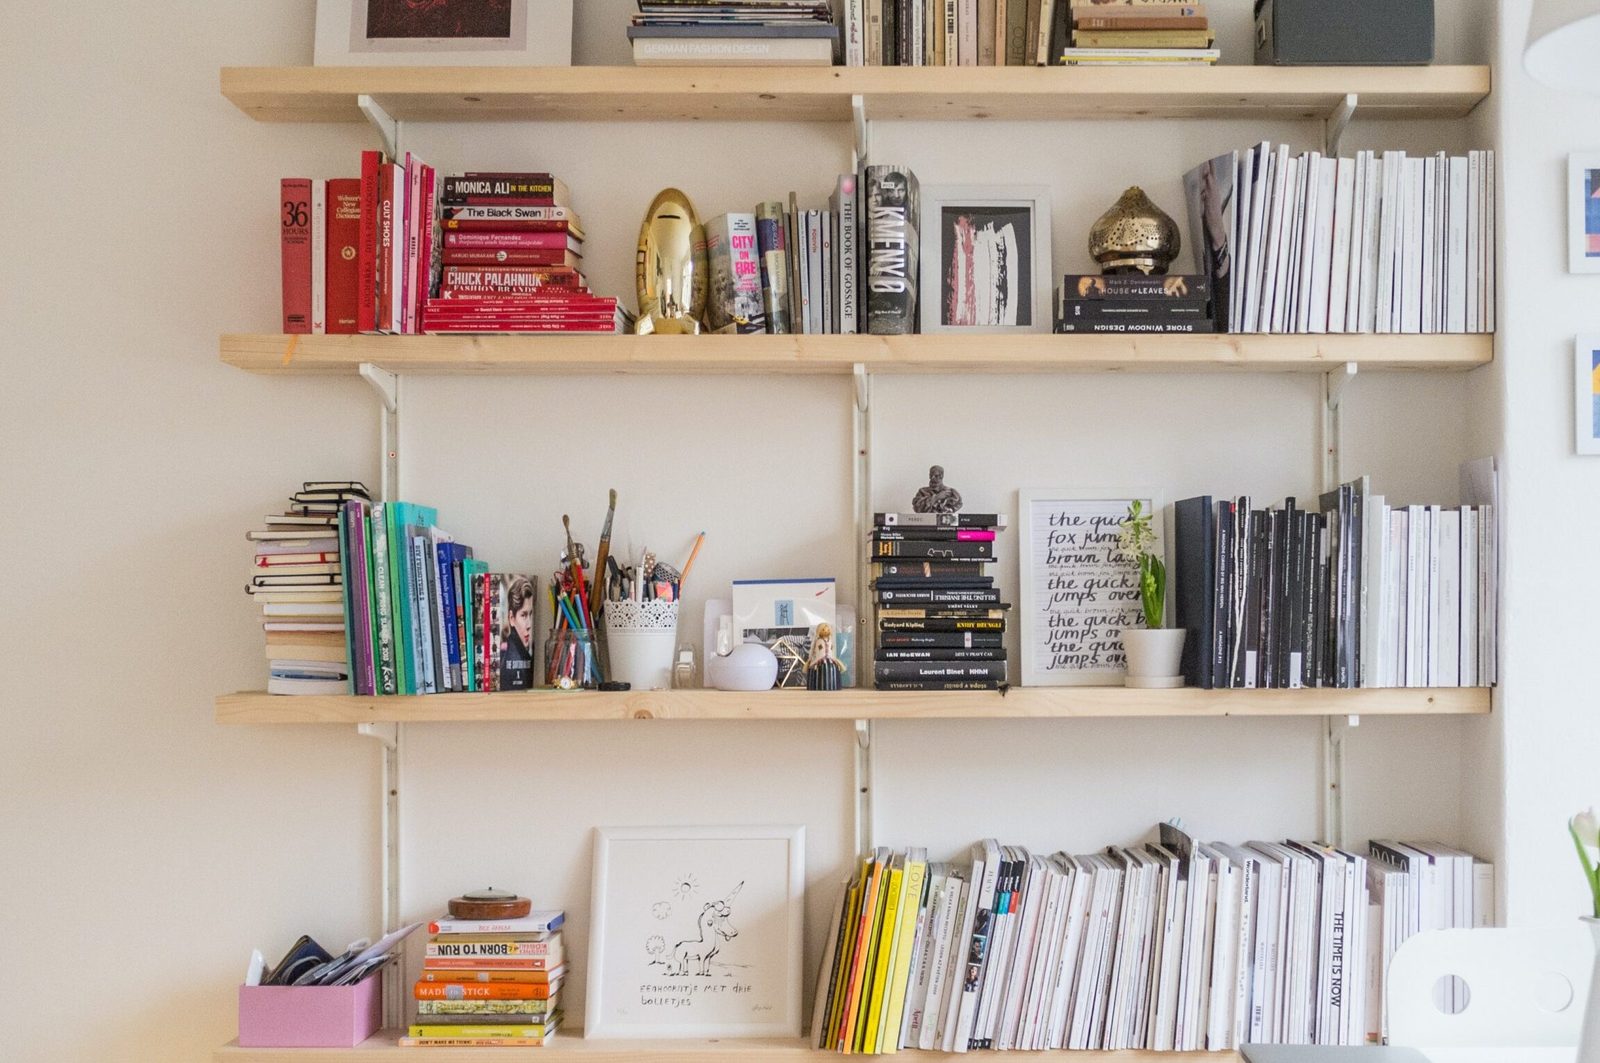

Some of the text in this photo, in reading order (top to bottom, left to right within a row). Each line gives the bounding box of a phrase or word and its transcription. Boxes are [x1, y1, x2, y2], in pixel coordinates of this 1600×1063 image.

[644, 44, 769, 54] GERMAN FASHION DESIGN
[455, 182, 491, 194] MONICA
[494, 182, 510, 195] ALI
[283, 202, 308, 227] 36
[383, 200, 391, 218] CULT
[467, 208, 541, 217] The Black Swan
[458, 234, 490, 242] Dominique
[732, 235, 754, 249] CITY
[739, 251, 749, 260] ON
[844, 201, 853, 319] THE BOOK OF GOSSAGE
[735, 262, 756, 275] FIRE
[447, 272, 542, 287] CHUCK PALAHNIUK
[1101, 287, 1129, 295] HOUSE
[1138, 287, 1169, 295] LEAVES
[1048, 512, 1087, 526] the
[1047, 530, 1077, 547] fox
[1046, 550, 1100, 564] brown
[377, 567, 385, 589] CLEAN
[1048, 576, 1135, 598] the quick
[1043, 590, 1140, 610] jumps over
[1049, 614, 1079, 628] the
[1084, 614, 1131, 634] quick
[1044, 629, 1098, 645] jumps
[1051, 642, 1083, 652] the
[1047, 653, 1101, 670] jumps
[907, 864, 923, 898] LOVE
[437, 944, 508, 955] BORN TO RUN
[1330, 912, 1344, 1007] THE TIME IS NOW
